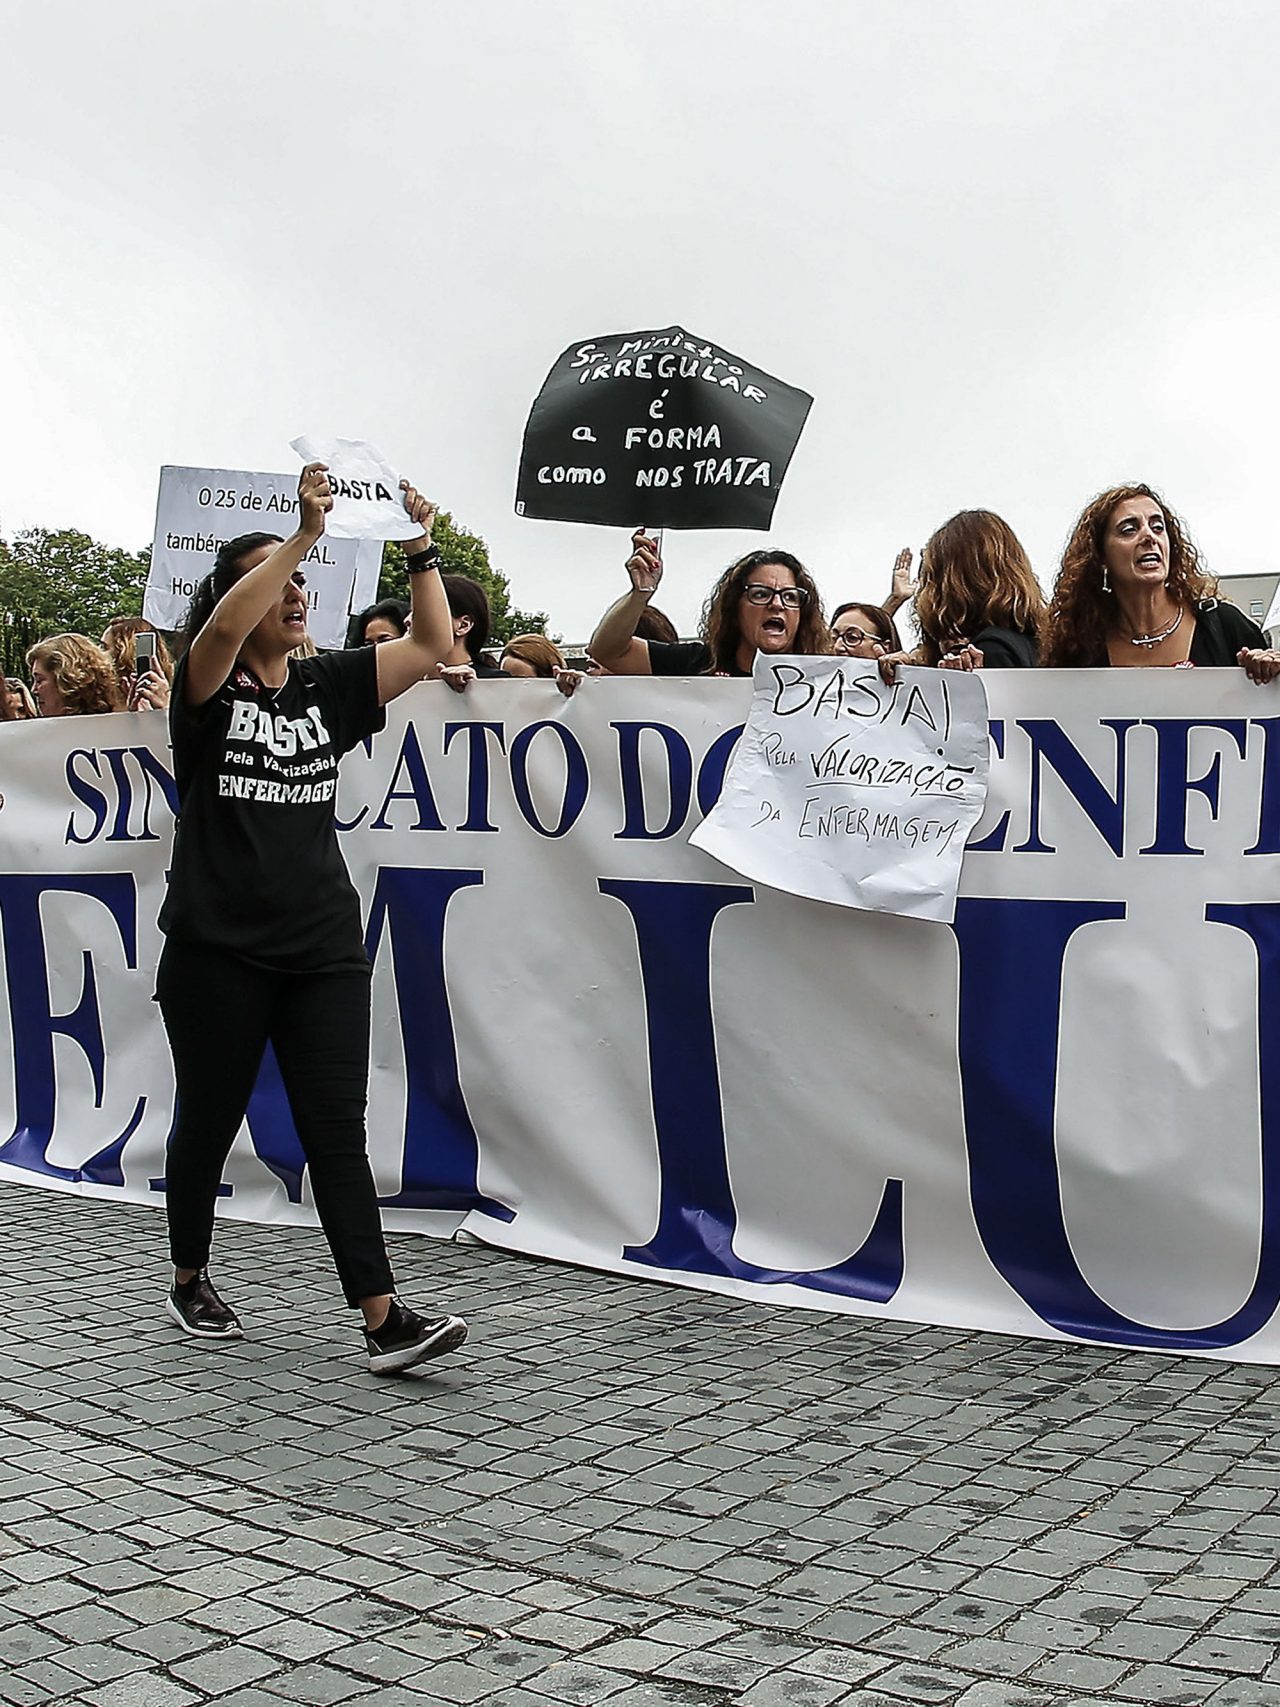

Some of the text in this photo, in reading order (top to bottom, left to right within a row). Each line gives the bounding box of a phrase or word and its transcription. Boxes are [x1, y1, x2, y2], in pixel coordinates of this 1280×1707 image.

[571, 344, 608, 367] Sr.
[579, 354, 768, 403] IRREGULAR
[625, 425, 722, 450] FORMA
[635, 466, 684, 488] NOS
[694, 457, 772, 488] TRATA
[328, 474, 393, 501] BASTA
[215, 490, 236, 508] 25
[241, 491, 262, 511] de
[266, 493, 299, 514] Abr
[172, 577, 199, 598] Hoj
[225, 751, 254, 765] Pela
[219, 775, 335, 803] ENFERMAGE
[799, 797, 958, 857] ENFERMAGEM
